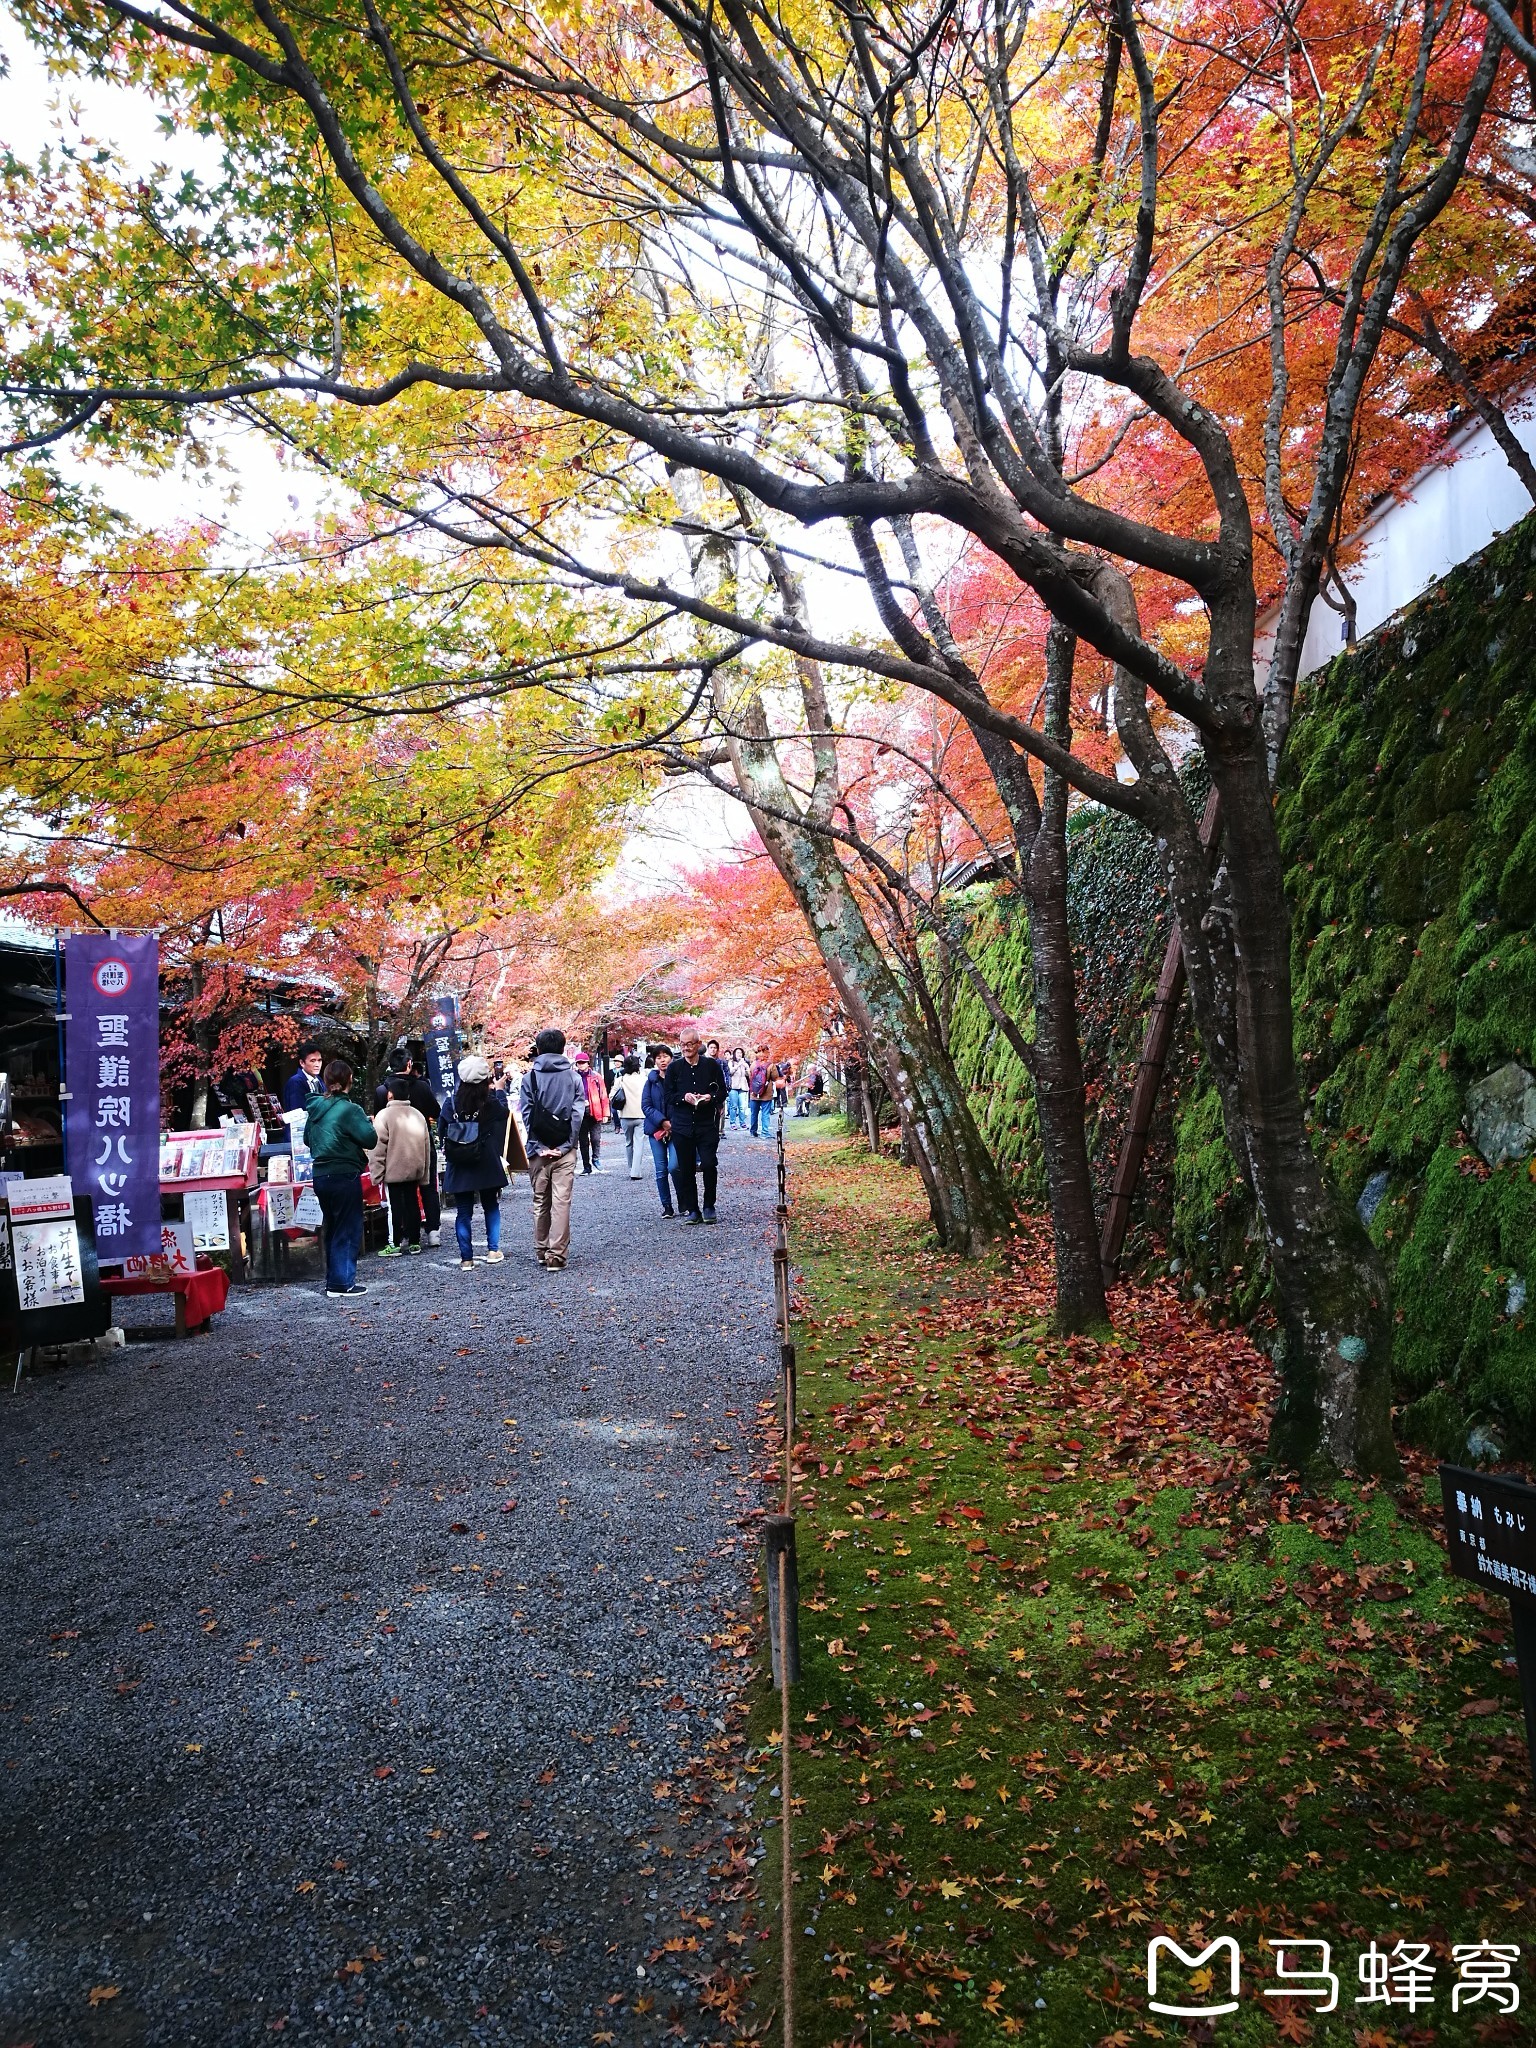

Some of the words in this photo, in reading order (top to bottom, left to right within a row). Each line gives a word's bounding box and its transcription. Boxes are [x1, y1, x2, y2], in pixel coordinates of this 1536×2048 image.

[1456, 1490, 1482, 1520] 奉納
[1493, 1505, 1527, 1532] もみじ
[1459, 1529, 1487, 1551] 東京都
